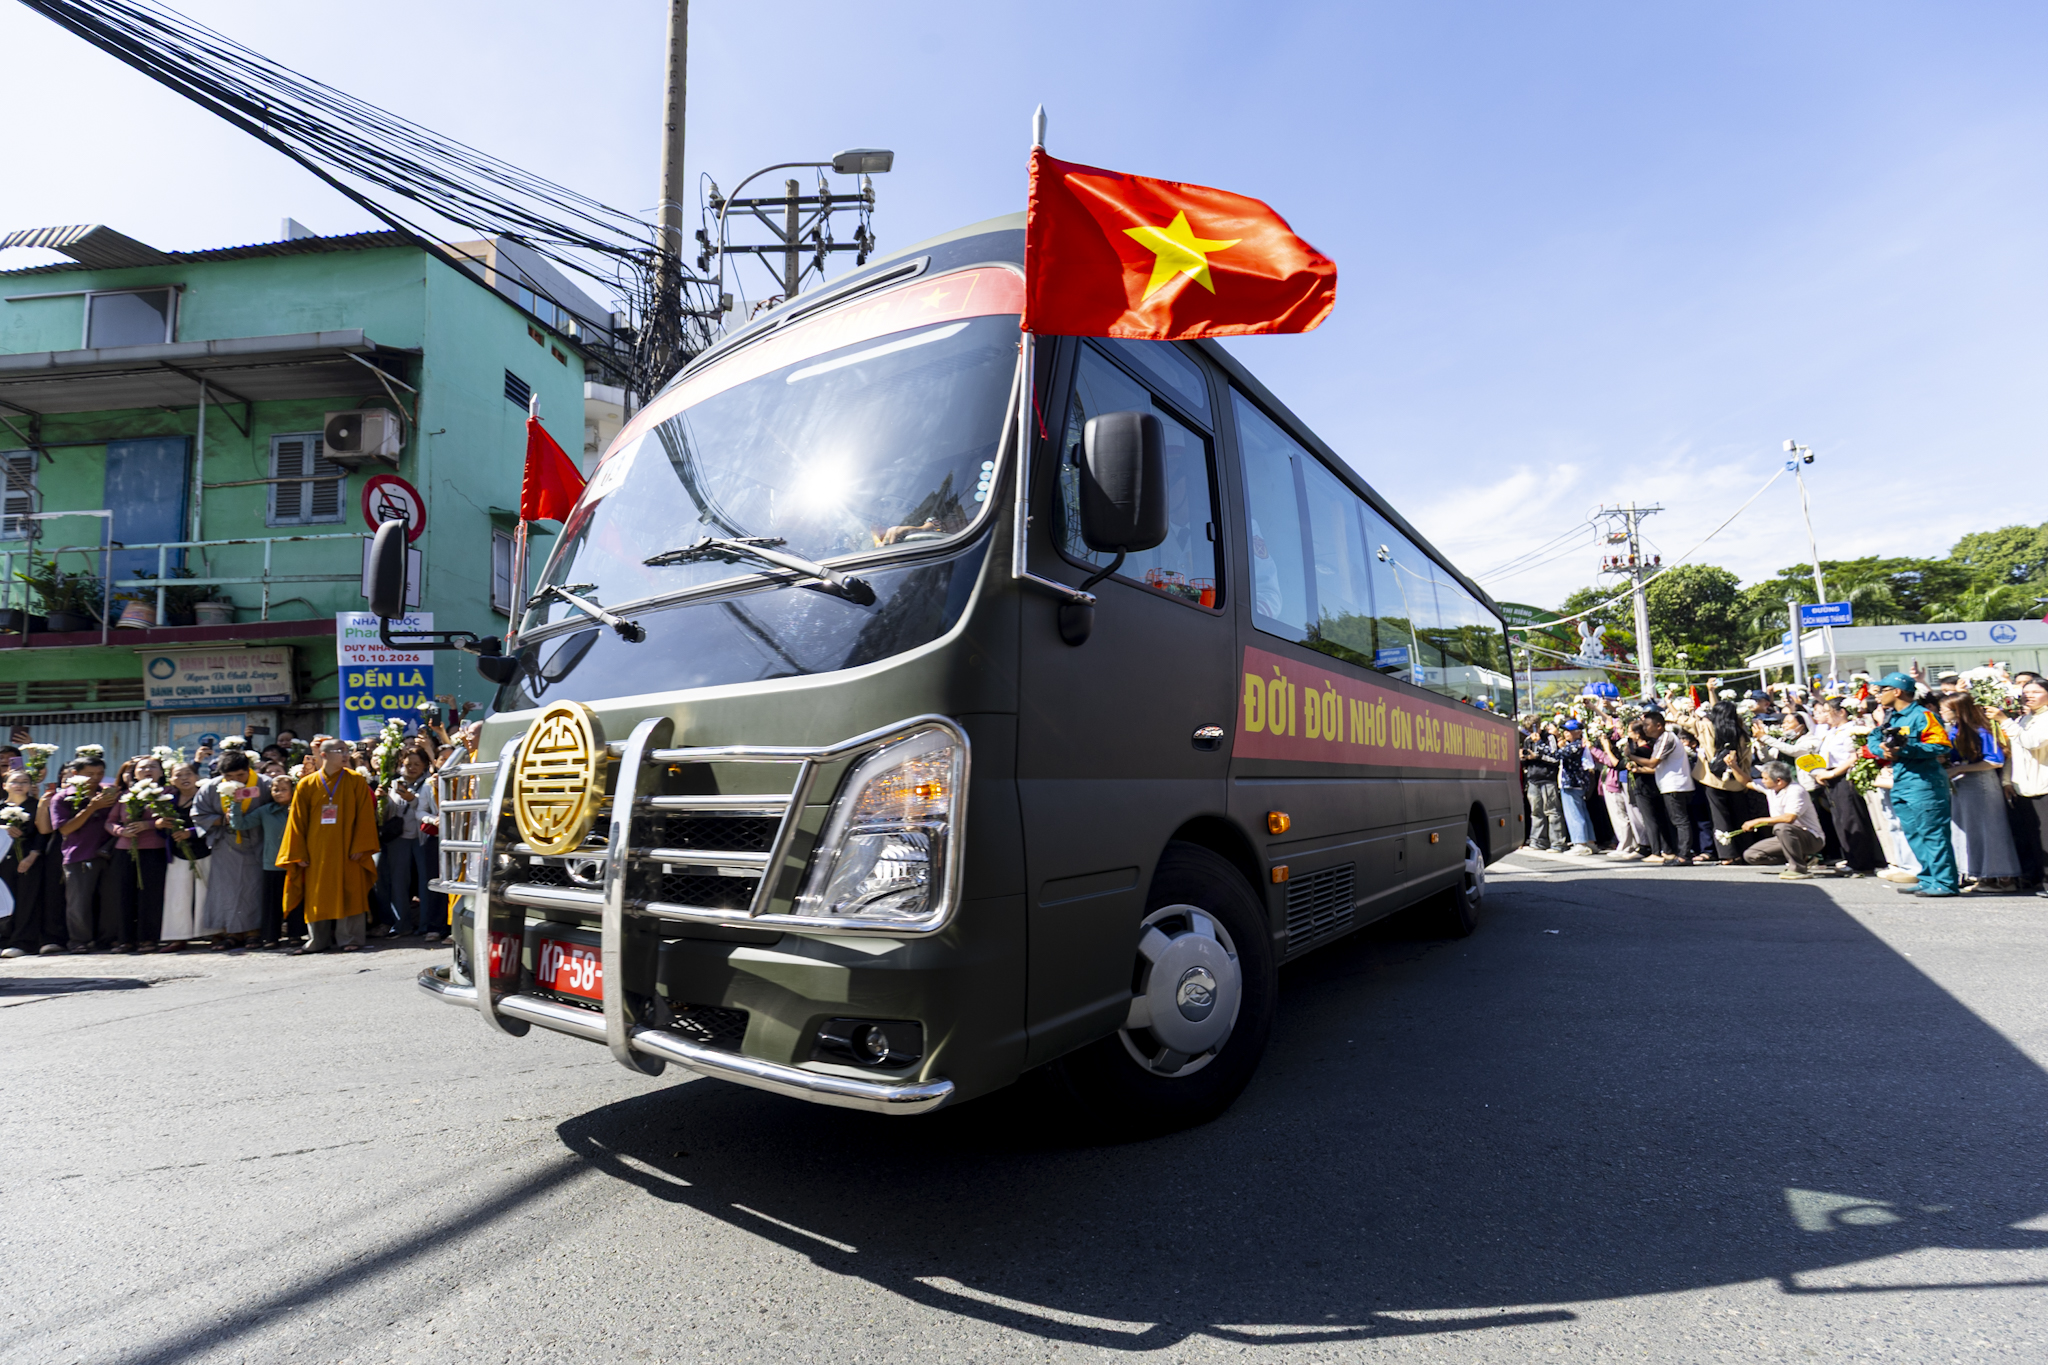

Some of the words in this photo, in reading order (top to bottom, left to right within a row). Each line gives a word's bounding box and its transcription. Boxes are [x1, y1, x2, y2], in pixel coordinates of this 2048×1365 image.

[1811, 604, 1840, 614] ĐƯỜNG
[352, 616, 378, 626] NHÀ
[388, 615, 420, 626] HUỐC
[1899, 630, 1967, 643] THACO
[351, 654, 420, 662] 10.10.2026
[348, 667, 393, 688] ĐẾN
[398, 668, 426, 687] LÀ
[150, 684, 174, 697] BÁNH
[211, 683, 234, 695] BÁNH
[344, 691, 376, 711] CÓ
[381, 691, 428, 710] QUÀ
[1244, 665, 1296, 737] ĐỜI
[1304, 679, 1344, 742] ĐỜI
[1349, 696, 1387, 748] NHỚ
[1391, 706, 1412, 750] ƠN
[1416, 709, 1441, 754] CÁC
[1443, 721, 1463, 756] ANH
[1464, 721, 1486, 759] HÙNG
[1486, 728, 1500, 766] LIỆT
